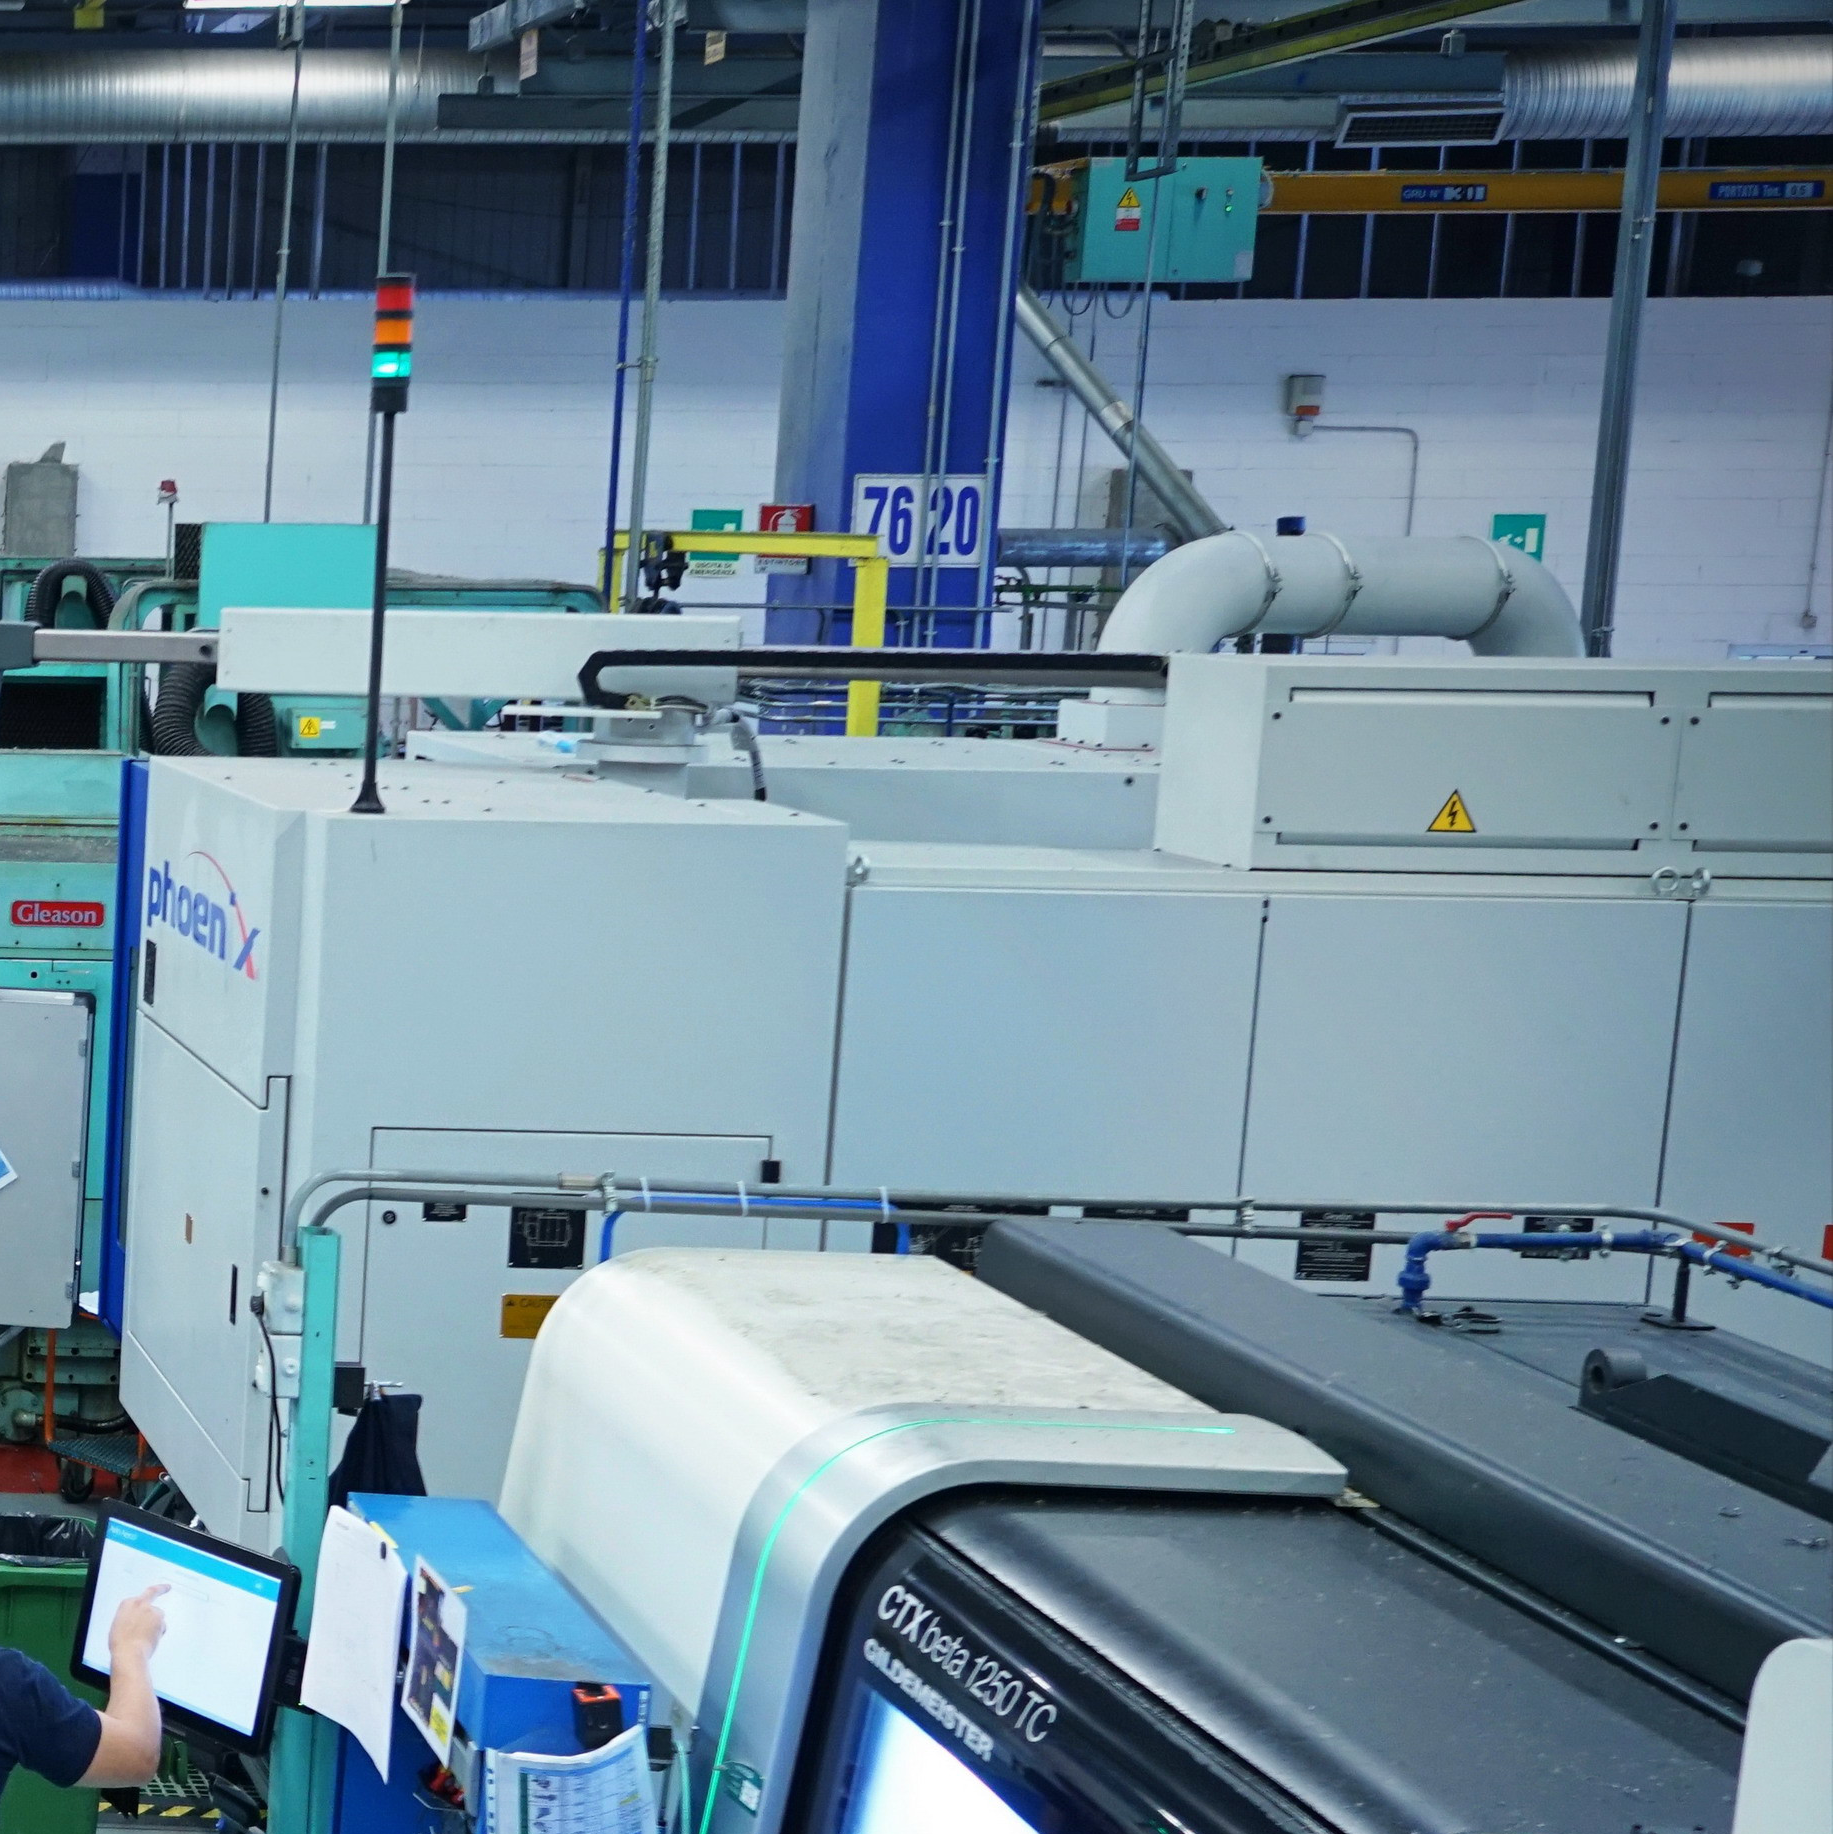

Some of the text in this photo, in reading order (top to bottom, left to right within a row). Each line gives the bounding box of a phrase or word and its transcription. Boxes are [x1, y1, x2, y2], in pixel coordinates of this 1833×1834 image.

[864, 486, 980, 556] 76 20
[17, 904, 97, 924] Gleason
[863, 1637, 993, 1763] GILDEMEISTER
[878, 1585, 1057, 1744] CTX beta 1250 TC
